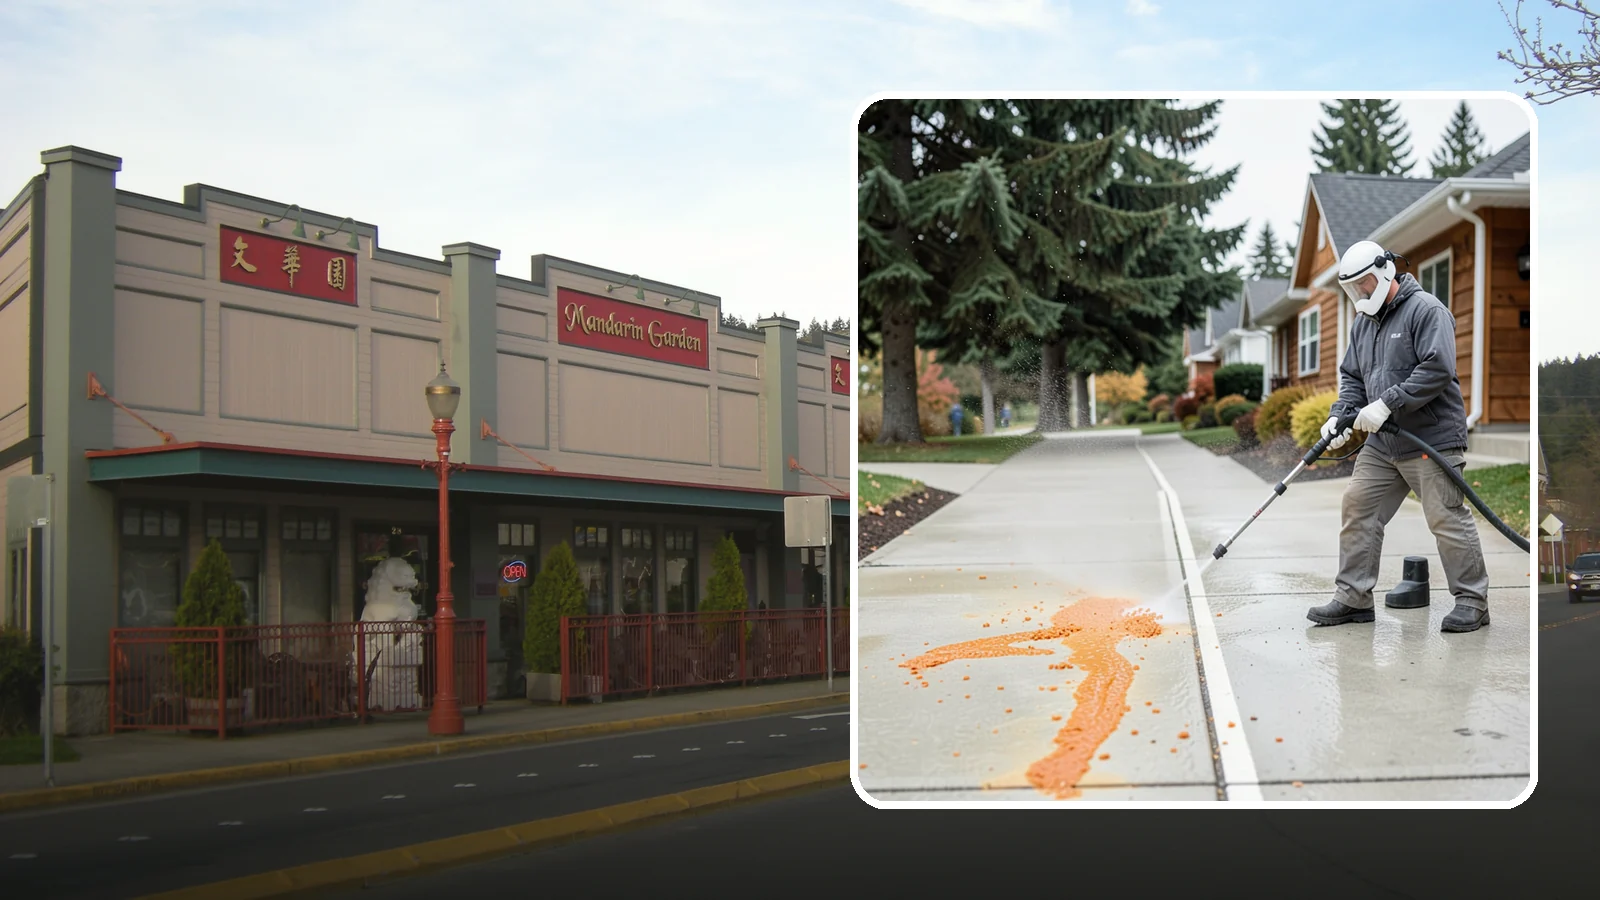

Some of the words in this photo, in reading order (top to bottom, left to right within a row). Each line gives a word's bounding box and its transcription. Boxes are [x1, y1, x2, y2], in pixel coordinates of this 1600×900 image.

[231, 235, 346, 291] 文華園
[564, 302, 644, 341] Mandarin
[647, 320, 702, 352] Garden
[834, 363, 846, 386] 文
[503, 565, 527, 578] OPEN
